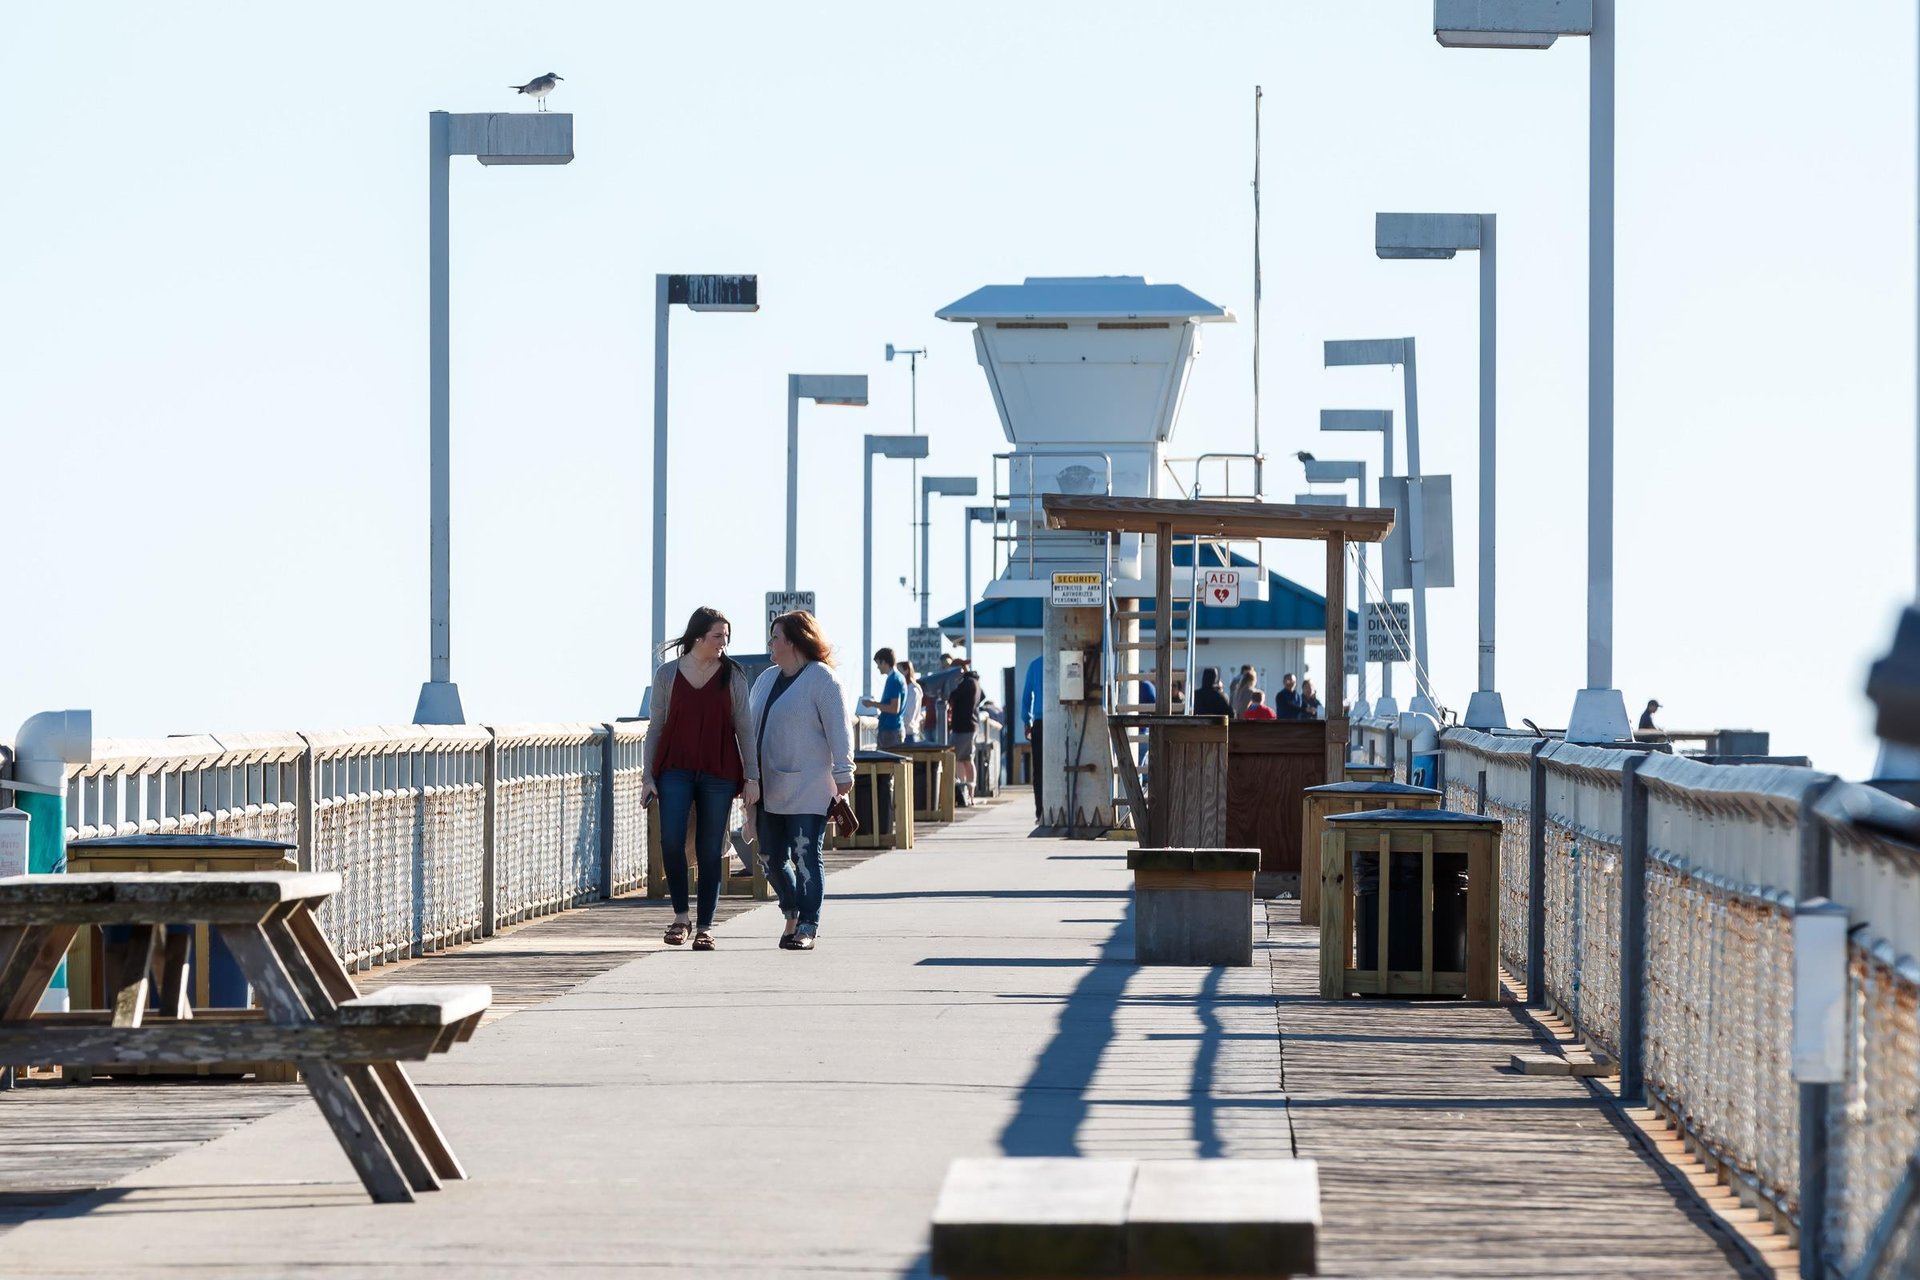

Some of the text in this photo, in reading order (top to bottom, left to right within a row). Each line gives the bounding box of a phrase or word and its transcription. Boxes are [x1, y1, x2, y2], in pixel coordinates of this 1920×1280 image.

[1057, 576, 1098, 584] SECURITY
[1210, 573, 1235, 584] AED
[769, 593, 812, 605] JUMPING
[1368, 603, 1407, 615] JUMPING
[1368, 618, 1408, 631] DIVING
[909, 639, 941, 649] DIVING
[1368, 634, 1389, 645] FROM
[1368, 649, 1409, 660] PROHIBITED
